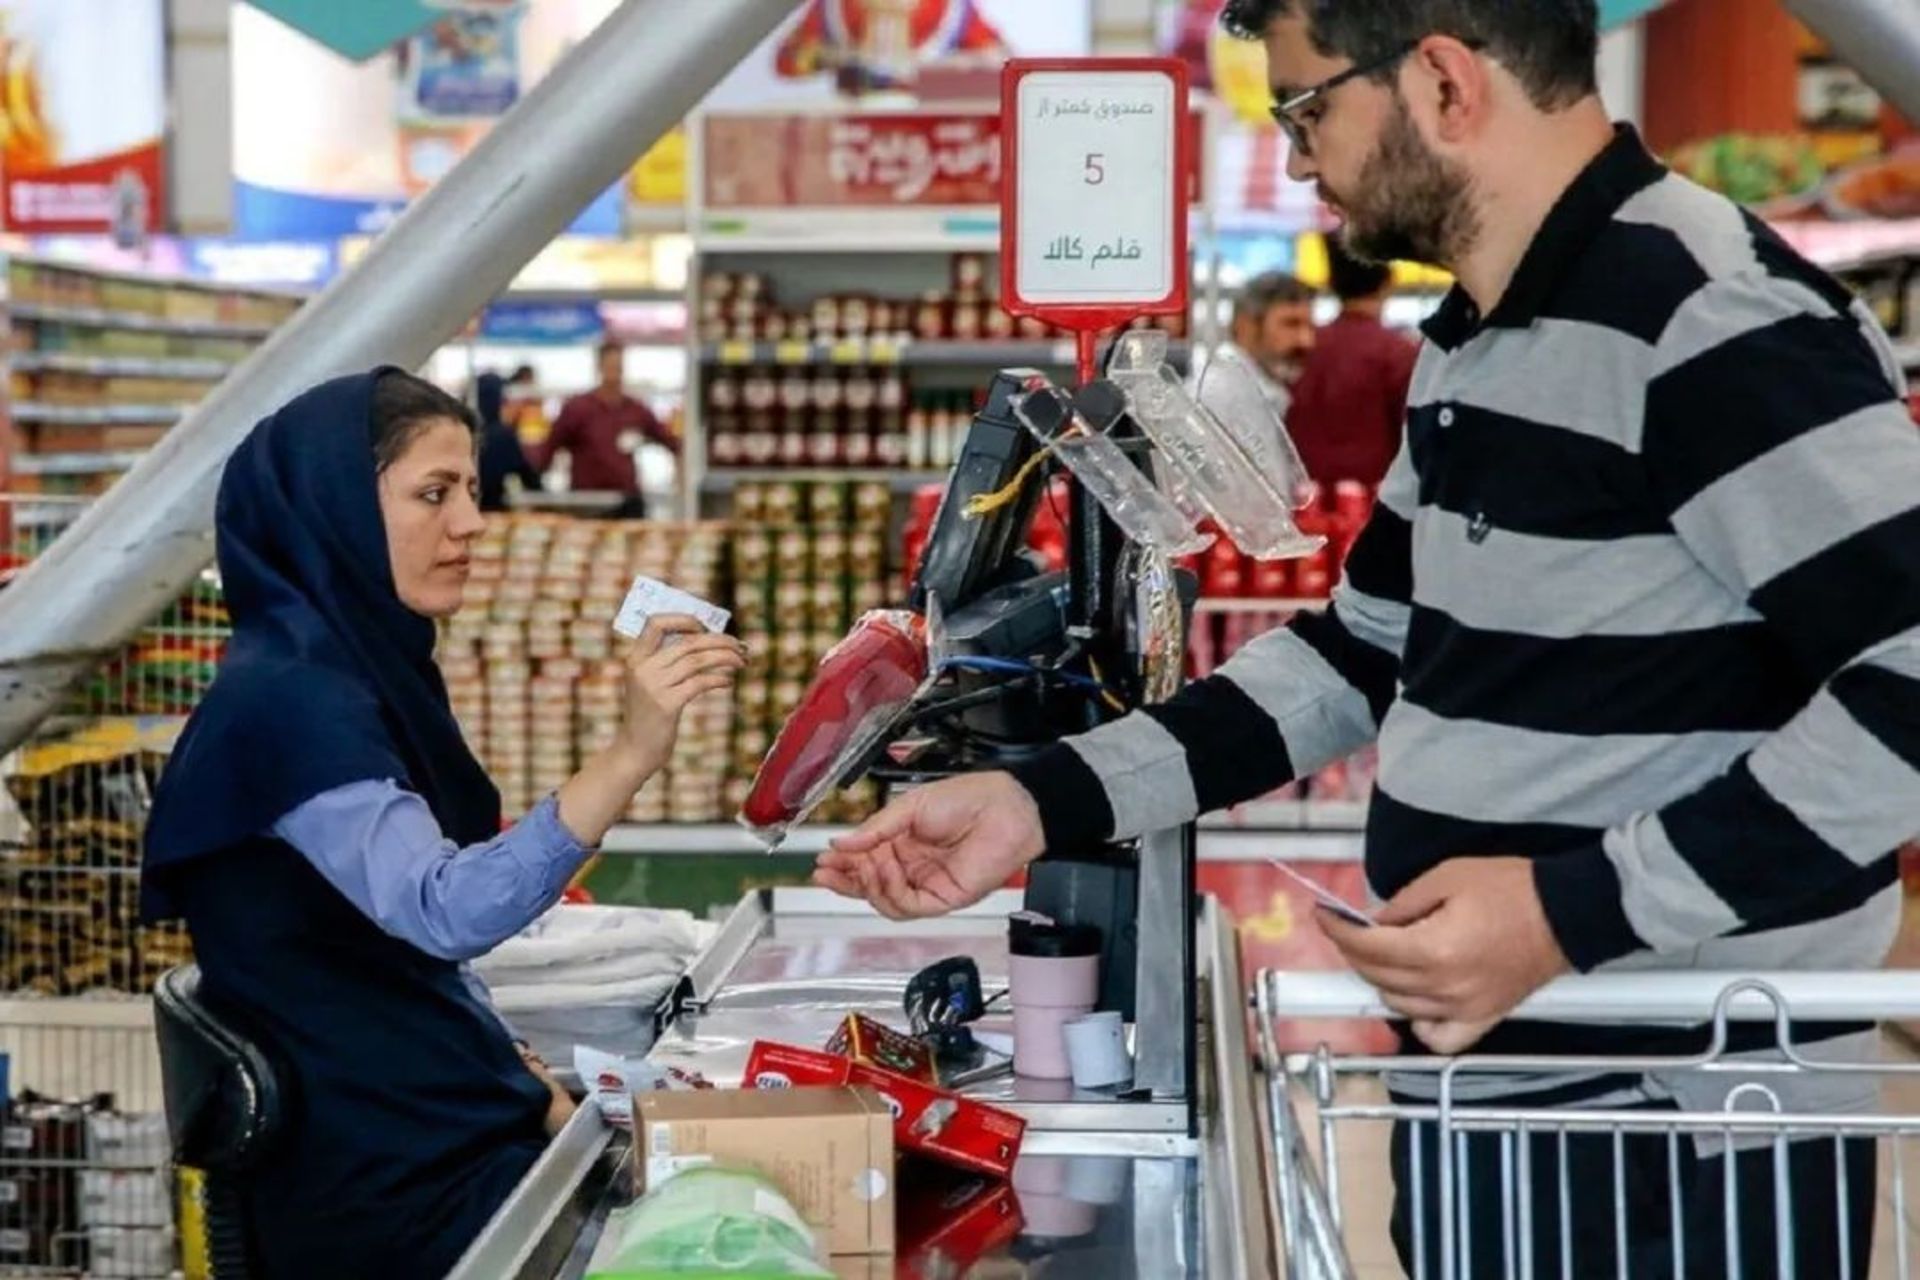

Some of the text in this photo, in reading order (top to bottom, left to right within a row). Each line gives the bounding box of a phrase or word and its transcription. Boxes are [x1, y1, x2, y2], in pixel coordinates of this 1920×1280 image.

[1084, 153, 1105, 186] 5
[1042, 234, 1142, 270] قلم کالا
